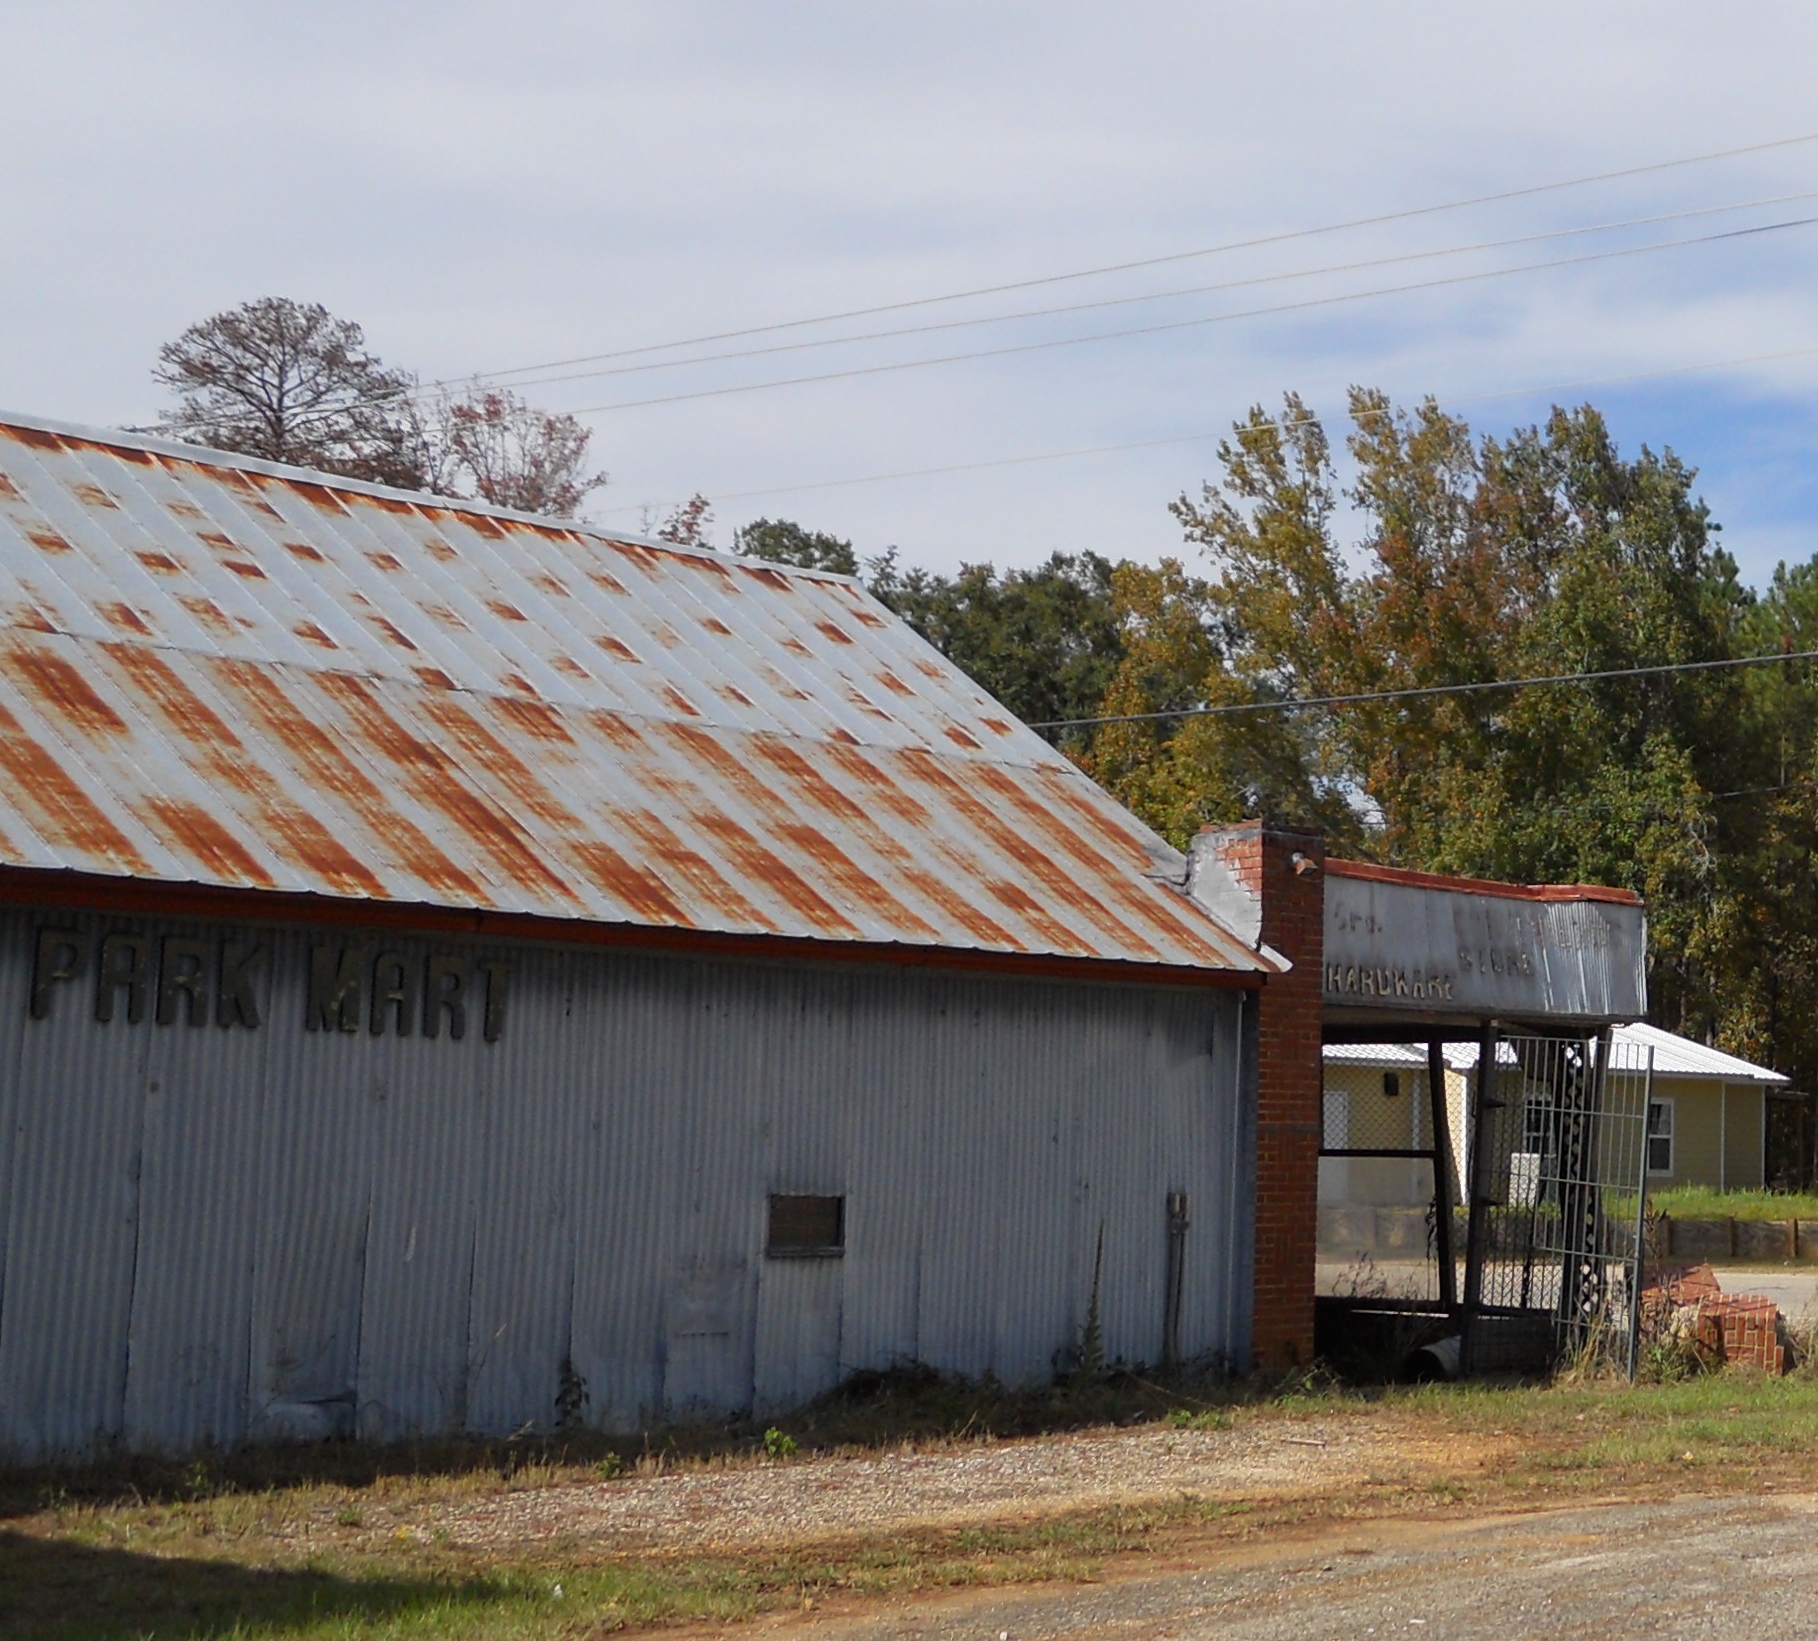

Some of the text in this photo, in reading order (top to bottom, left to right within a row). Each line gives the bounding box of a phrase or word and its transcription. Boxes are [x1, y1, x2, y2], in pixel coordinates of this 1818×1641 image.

[30, 926, 519, 1043] PARK MART
[1326, 964, 1453, 1000] HARDWARE
